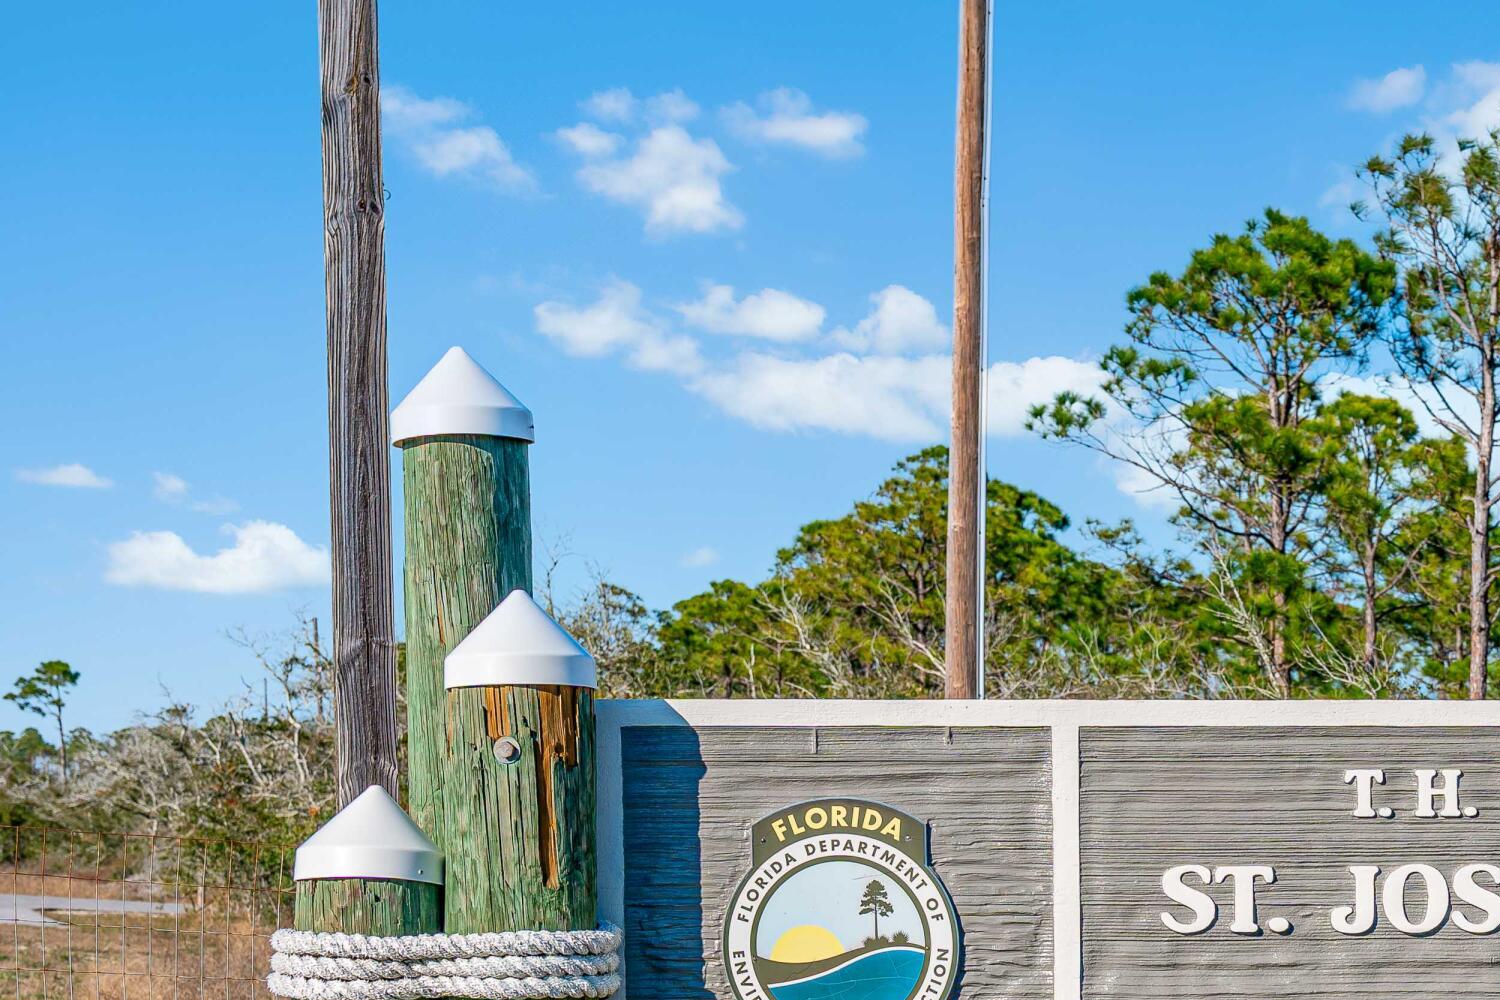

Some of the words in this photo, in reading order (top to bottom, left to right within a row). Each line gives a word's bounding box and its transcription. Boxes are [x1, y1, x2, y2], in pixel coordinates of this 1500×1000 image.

[1343, 768, 1393, 818] T.
[1414, 768, 1479, 818] H.
[771, 805, 903, 842] FLORIDA
[737, 851, 797, 923] FLORIDA
[804, 839, 928, 891] DEPARTMENT
[926, 897, 944, 922] OF
[1158, 866, 1291, 936] ST.
